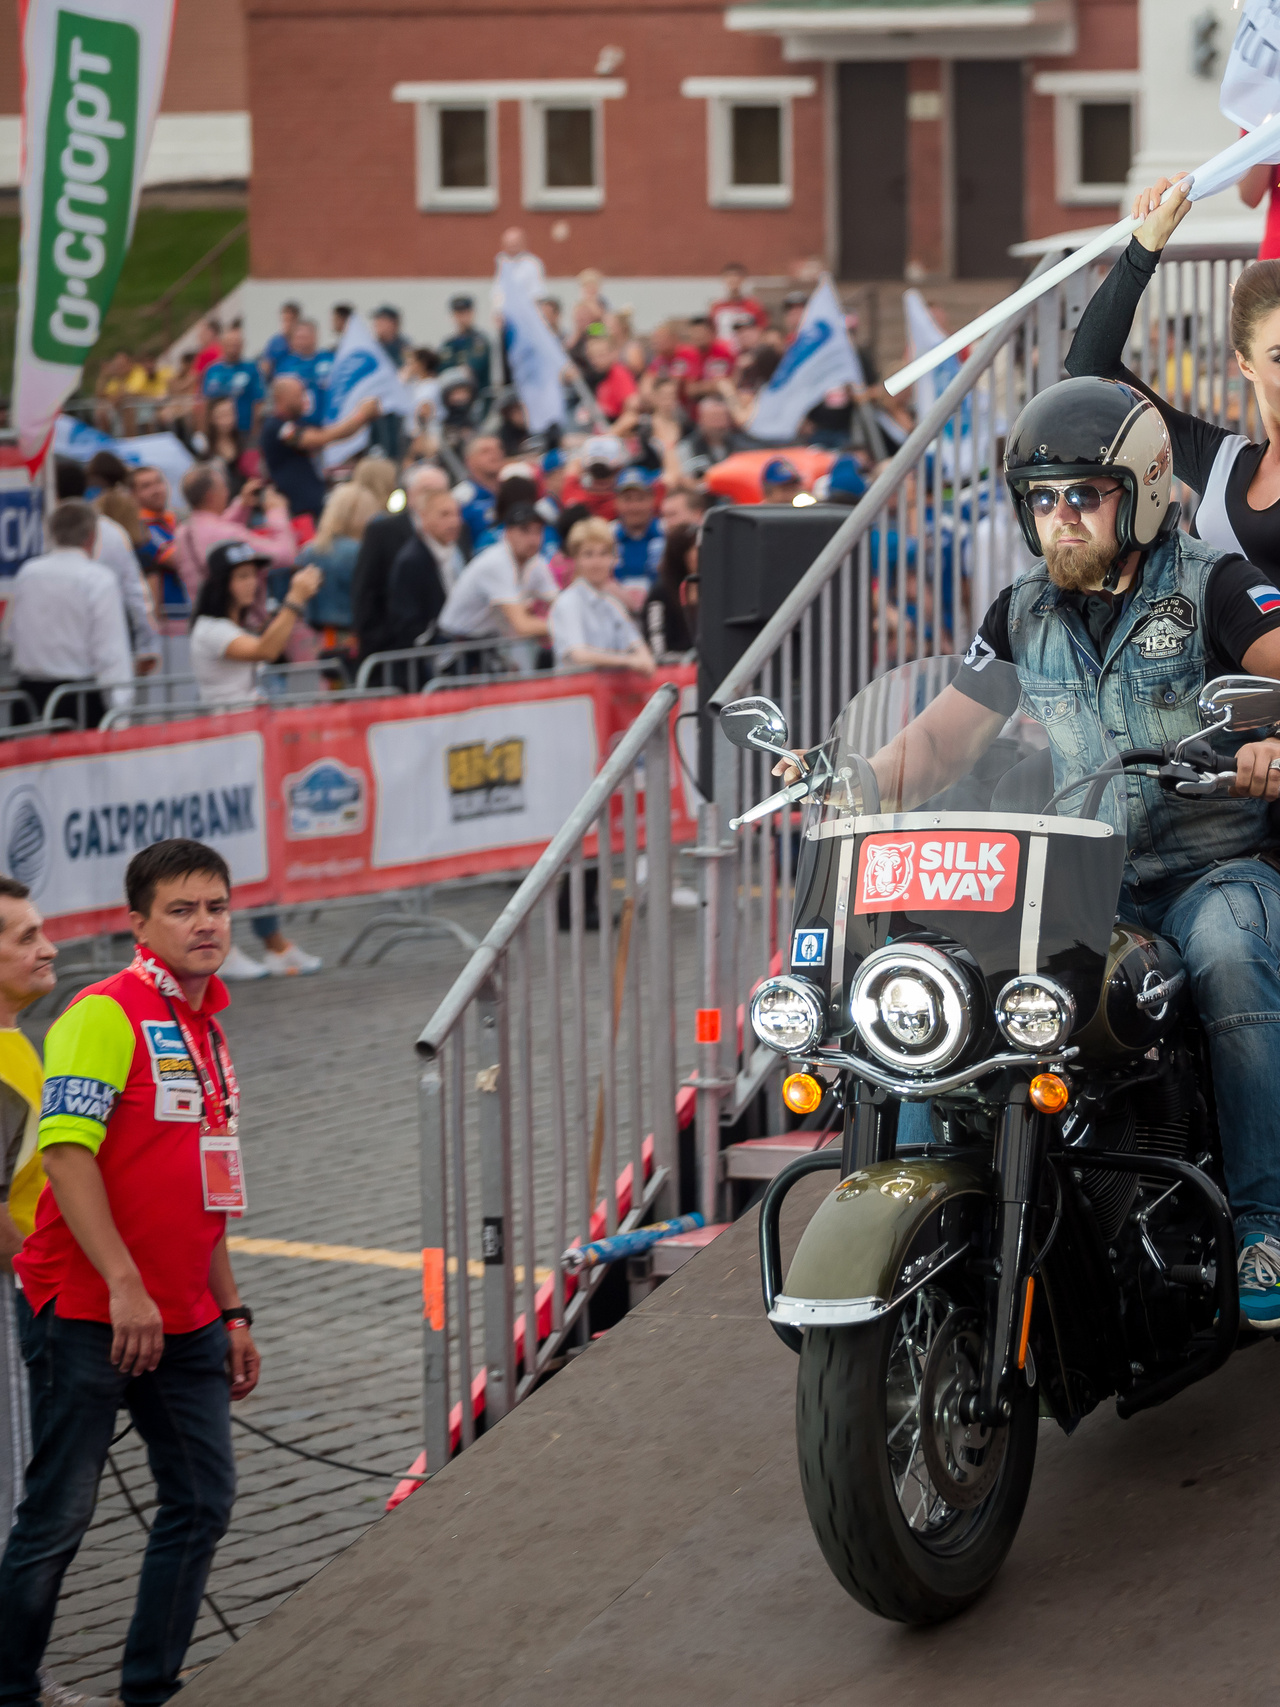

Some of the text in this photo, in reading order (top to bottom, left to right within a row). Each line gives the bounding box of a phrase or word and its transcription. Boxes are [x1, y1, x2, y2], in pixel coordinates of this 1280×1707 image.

[64, 784, 257, 860] GAZPROMBANK
[919, 841, 1006, 872] SILK
[918, 872, 1005, 902] WAY
